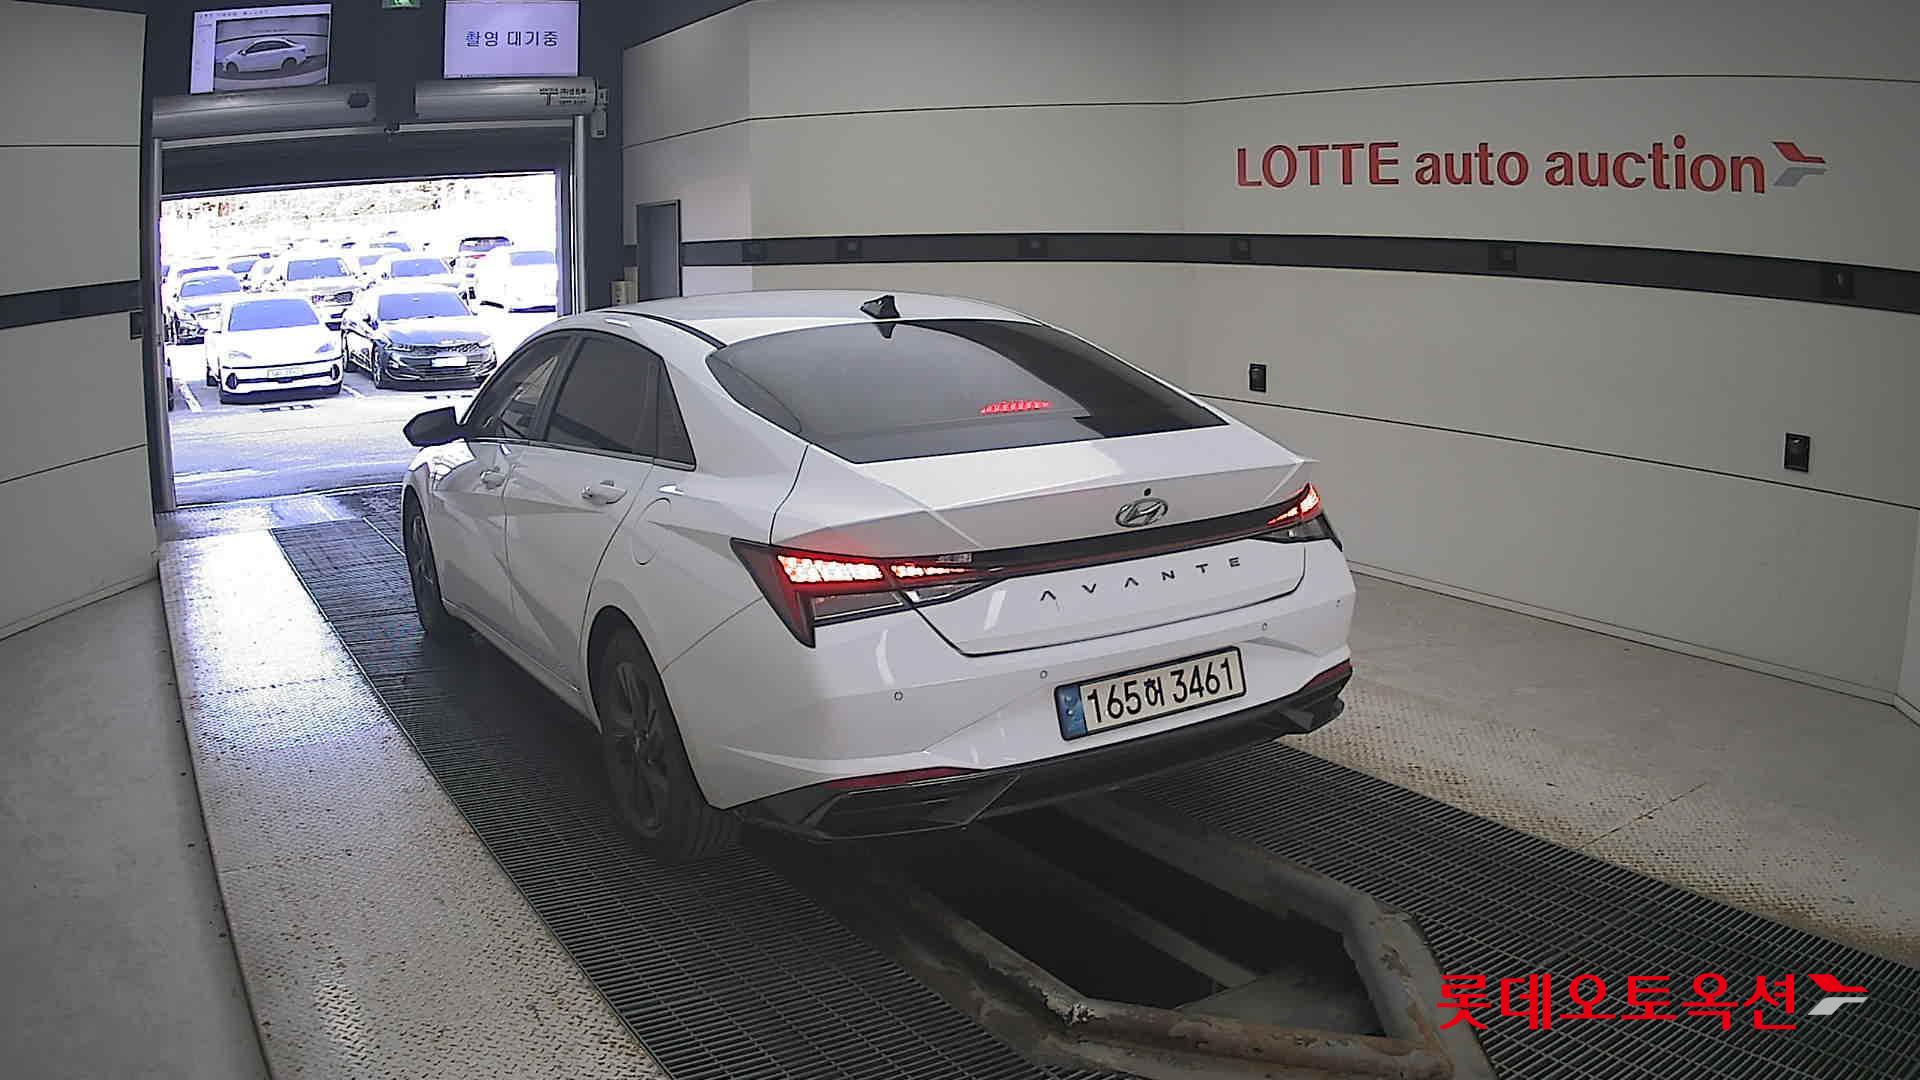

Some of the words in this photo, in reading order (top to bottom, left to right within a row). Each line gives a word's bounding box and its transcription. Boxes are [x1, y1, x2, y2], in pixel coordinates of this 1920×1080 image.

[466, 31, 498, 47] 촬영
[507, 31, 558, 47] 대기중
[1237, 142, 1399, 188] LOTTE
[1415, 142, 1529, 186] auto
[1545, 134, 1765, 194] auction
[1040, 557, 1241, 601] AVANTE
[1087, 677, 1165, 723] 165허
[1170, 657, 1234, 703] 3461
